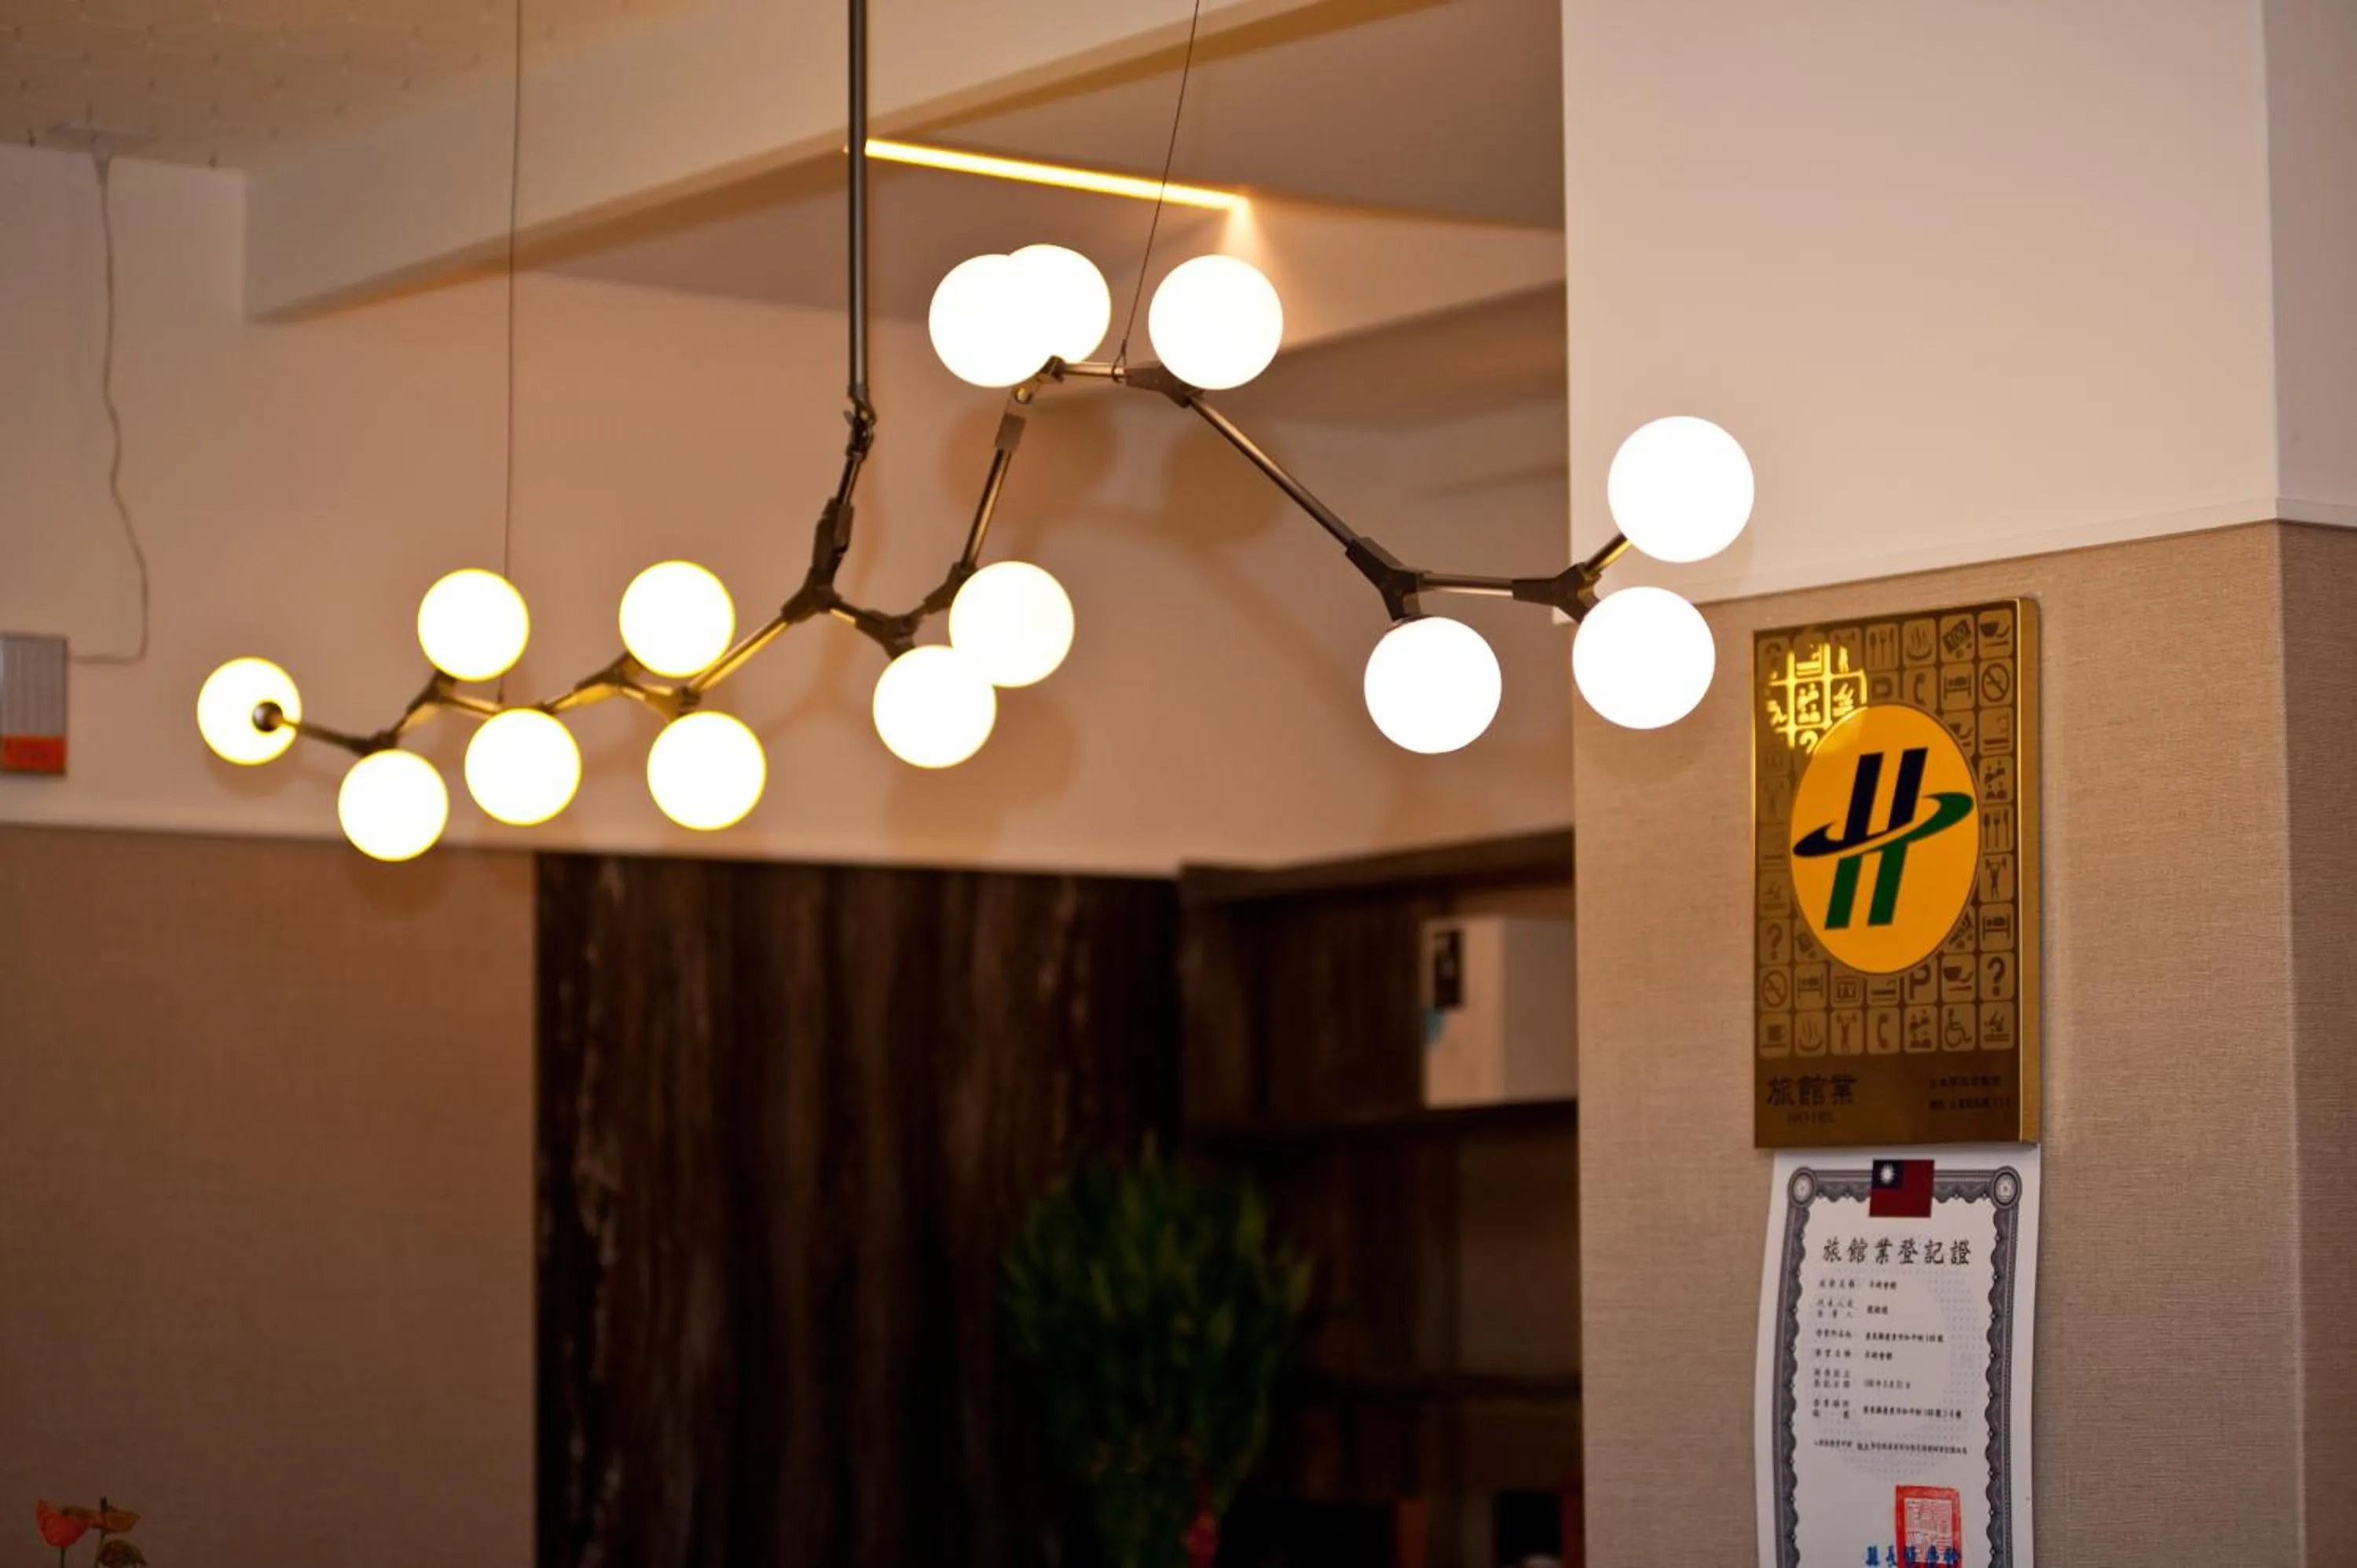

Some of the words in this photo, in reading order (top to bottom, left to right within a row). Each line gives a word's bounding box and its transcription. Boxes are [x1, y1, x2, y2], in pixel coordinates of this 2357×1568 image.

[1767, 1074, 1857, 1106] 旅館業
[1823, 1236, 1971, 1265] 旅館業登記證
